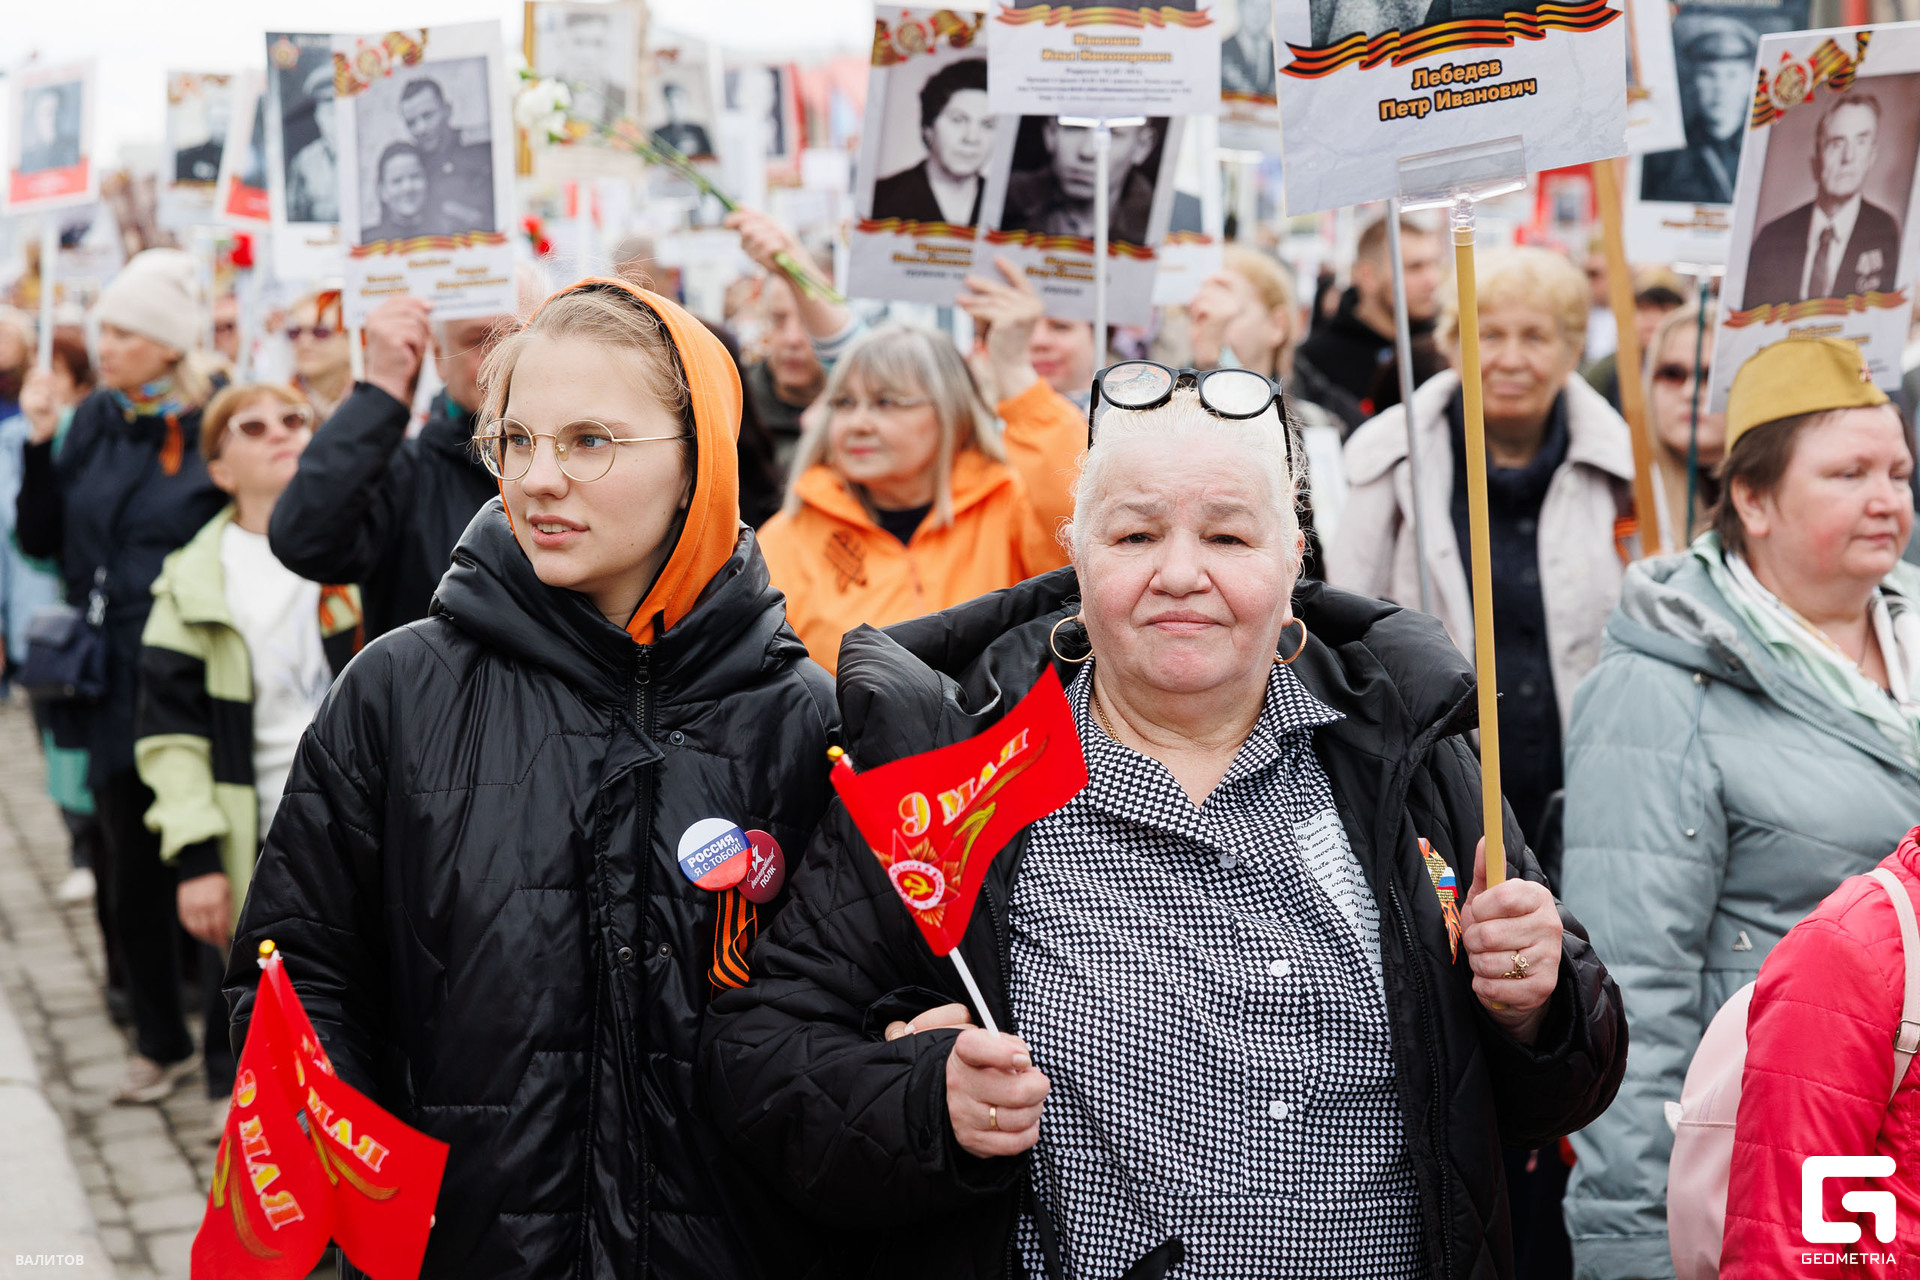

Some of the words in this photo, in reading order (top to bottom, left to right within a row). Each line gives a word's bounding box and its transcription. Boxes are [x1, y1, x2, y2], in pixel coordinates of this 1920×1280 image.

[1411, 59, 1502, 90] Лебедев
[1379, 97, 1432, 121] Петр
[1434, 78, 1537, 111] Иванович
[898, 792, 931, 837] 9
[937, 728, 1029, 826] МАЯ
[687, 833, 739, 869] РОССИЯ,
[694, 866, 703, 877] Я
[703, 861, 711, 871] С
[709, 843, 743, 867] ТОБОЙ!
[760, 864, 777, 888] ПОЛК
[307, 1086, 390, 1173] МАЯ
[239, 1114, 305, 1231] МАЯ
